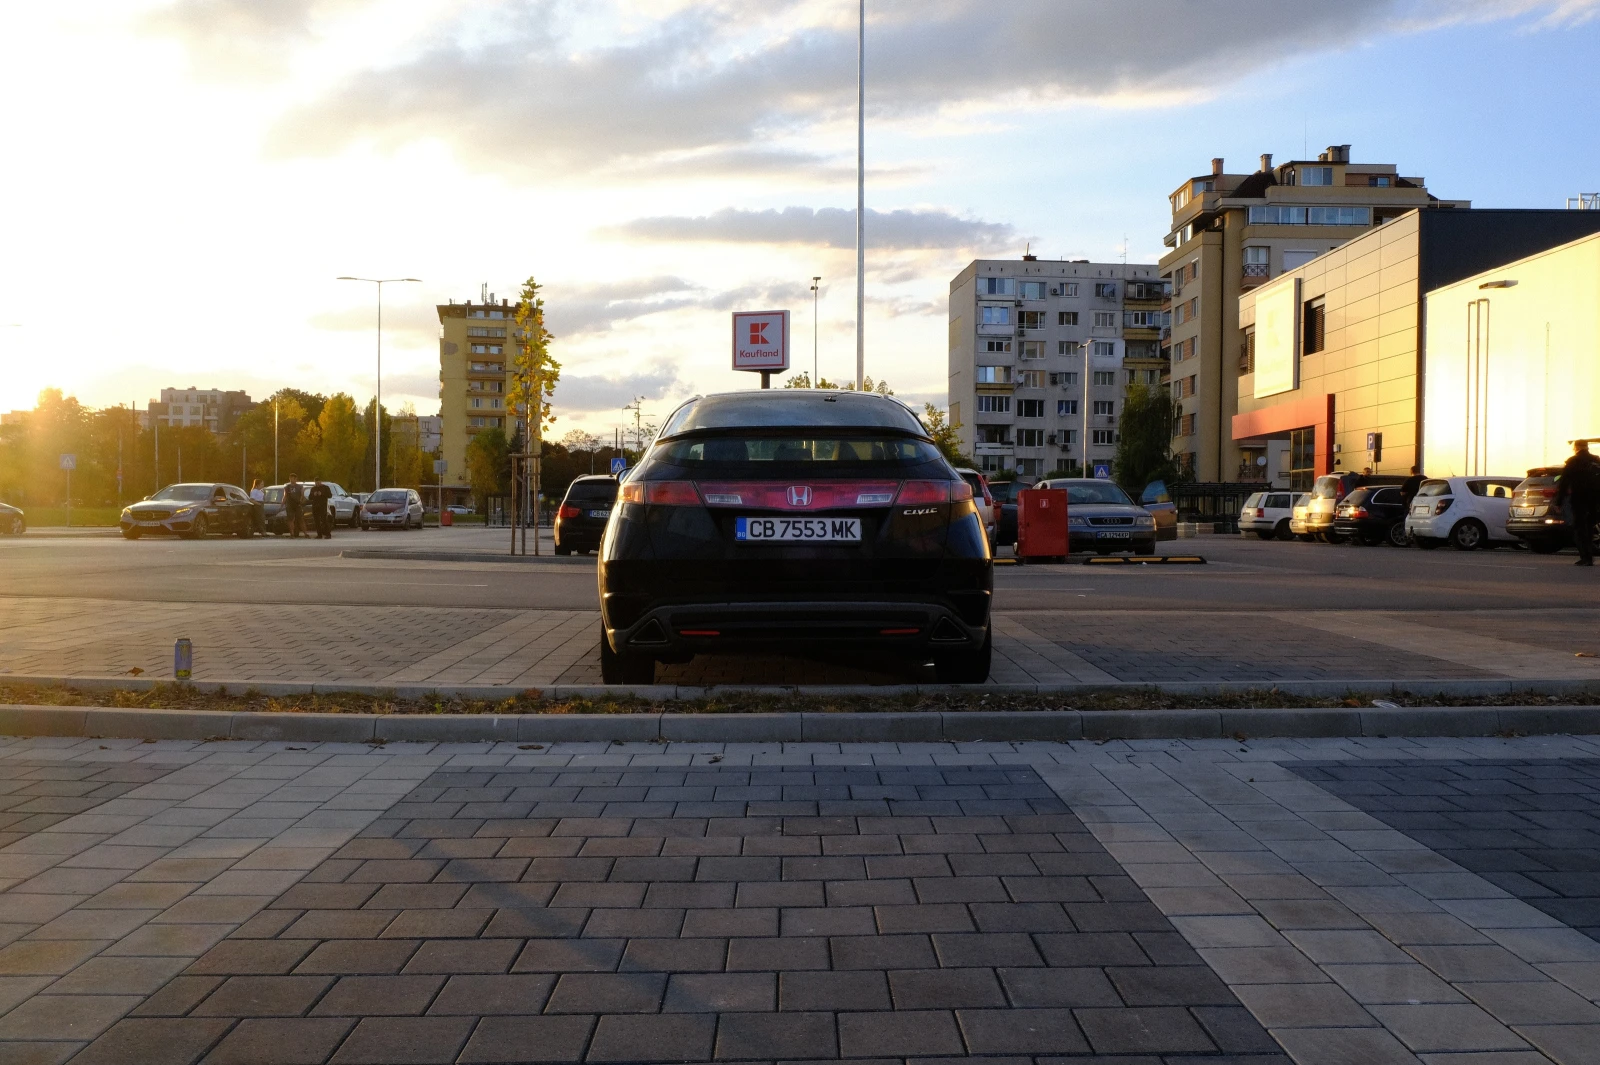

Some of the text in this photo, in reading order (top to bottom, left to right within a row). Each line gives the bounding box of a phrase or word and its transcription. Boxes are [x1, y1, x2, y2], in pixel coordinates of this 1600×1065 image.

[739, 349, 779, 358] Kaufland
[1368, 435, 1374, 449] P
[903, 507, 938, 516] CIVIC
[749, 520, 857, 538] CB 7553 MK
